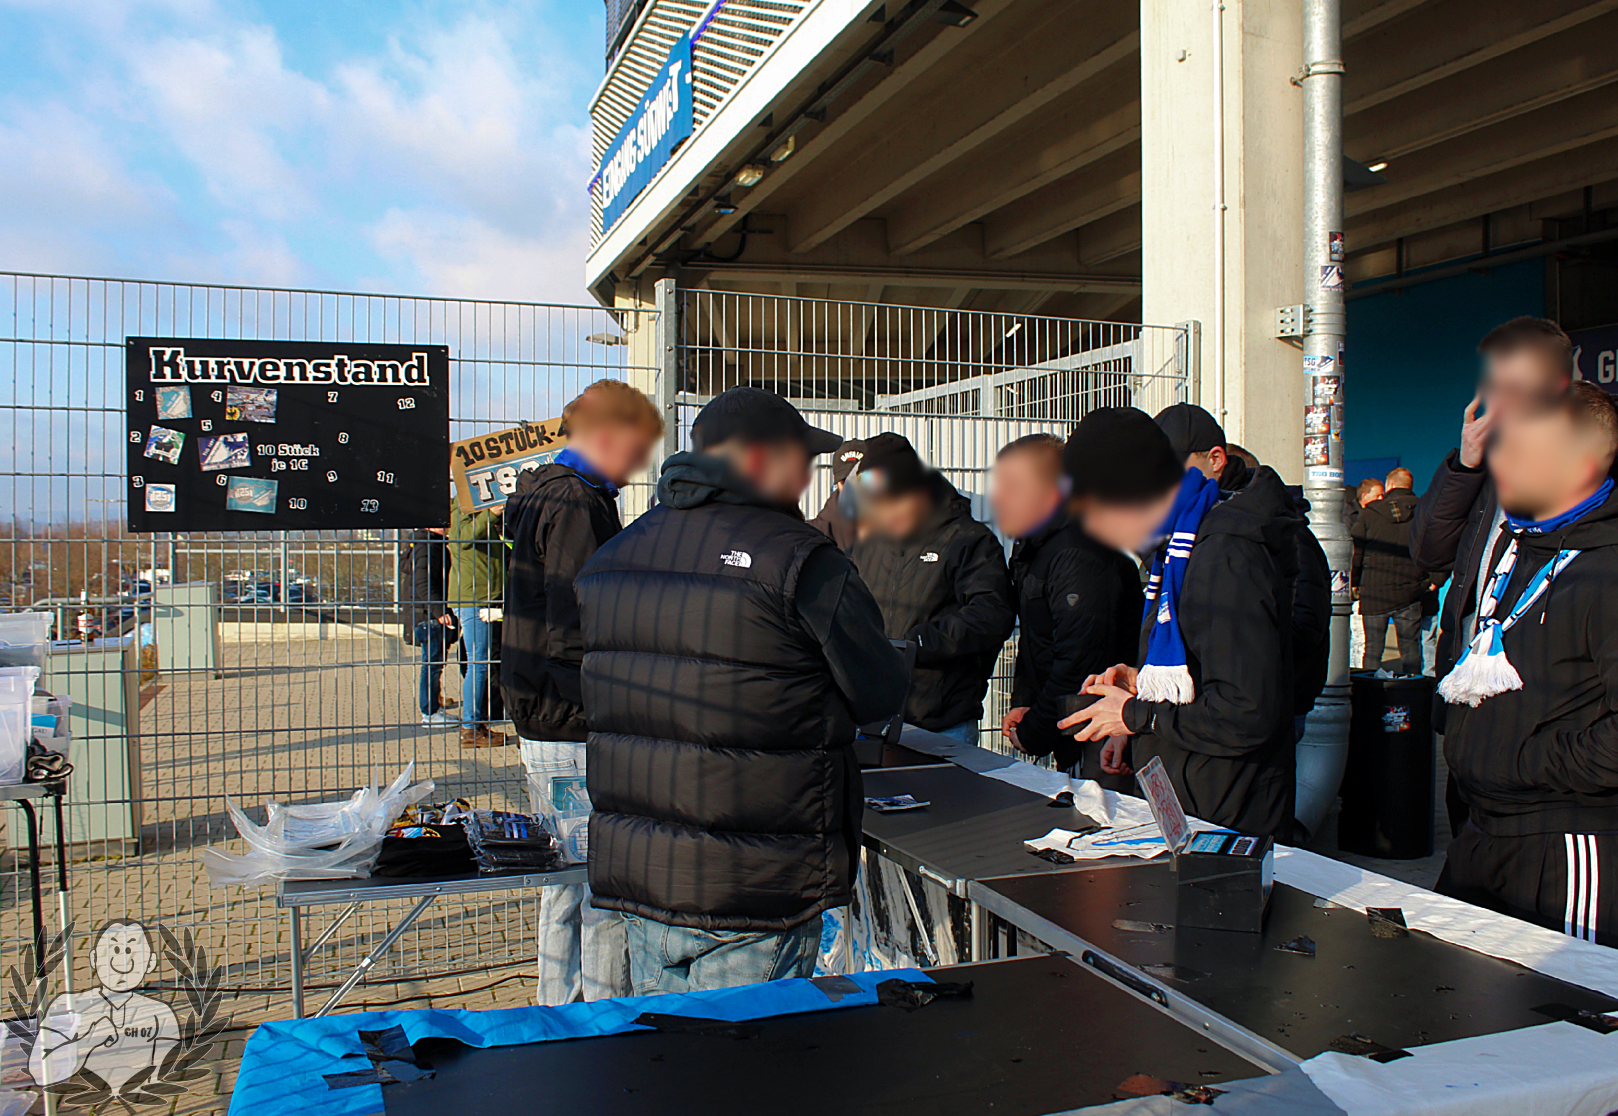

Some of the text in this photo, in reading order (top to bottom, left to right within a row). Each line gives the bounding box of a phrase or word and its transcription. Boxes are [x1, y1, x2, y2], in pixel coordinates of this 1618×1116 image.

[149, 346, 430, 386] Kurvenstand
[1597, 350, 1618, 384] G
[134, 389, 144, 401] 1
[211, 390, 222, 402] 4
[327, 391, 338, 402] 7
[396, 397, 415, 409] 12
[201, 419, 212, 432] 5
[130, 430, 142, 443] 2
[337, 432, 349, 443] 8
[256, 443, 320, 457] 10 Stück
[270, 457, 287, 472] je
[131, 475, 144, 487] 3
[216, 474, 228, 487] 6
[327, 470, 338, 482] 9
[376, 470, 395, 484] 11
[288, 497, 307, 510] 10
[361, 498, 380, 513] 13
[724, 559, 742, 567] FACE
